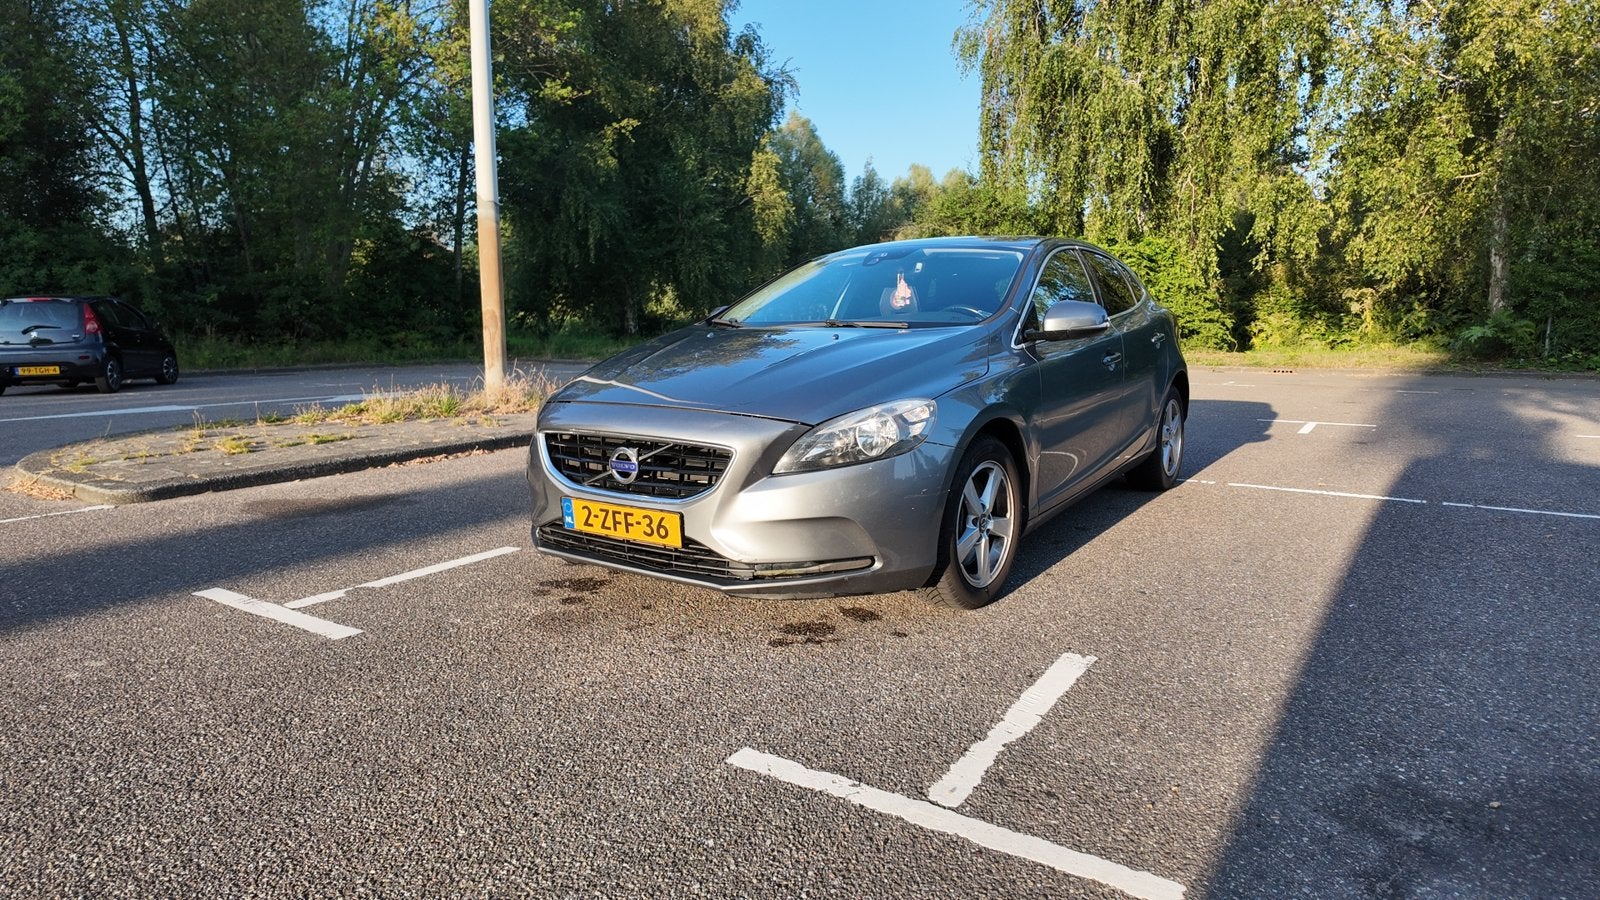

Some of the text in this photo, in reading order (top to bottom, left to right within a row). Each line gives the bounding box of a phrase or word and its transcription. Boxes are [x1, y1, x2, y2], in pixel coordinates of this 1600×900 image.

[611, 462, 635, 470] VOLVO
[565, 515, 574, 524] NL
[581, 505, 669, 539] 2-ZFF-36
